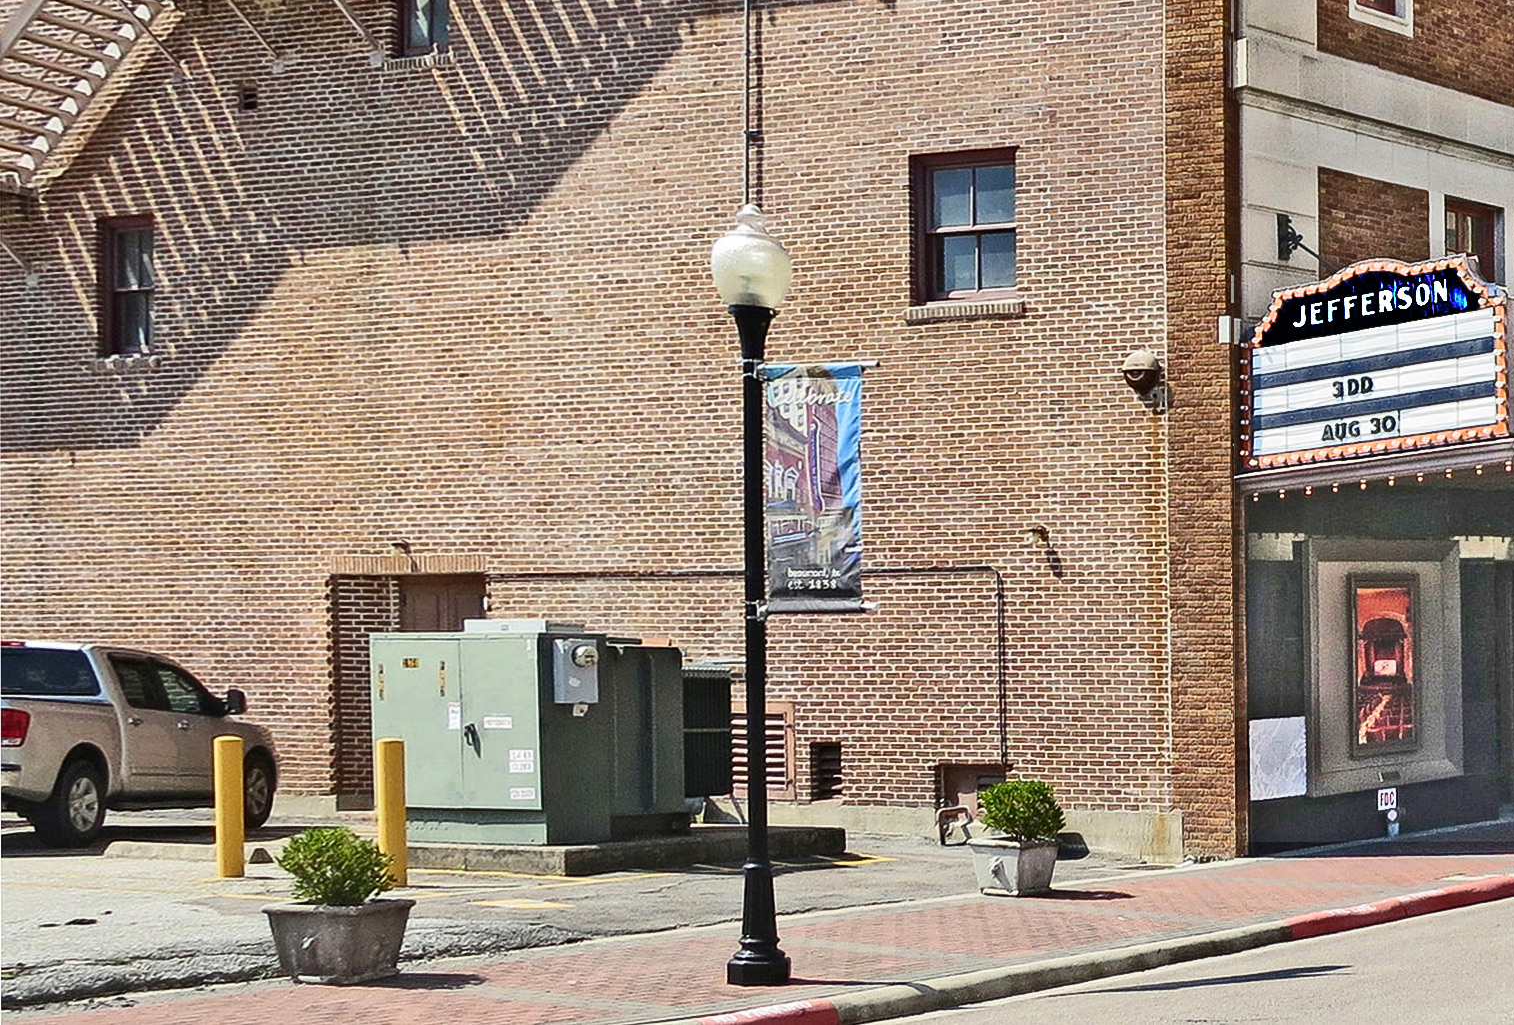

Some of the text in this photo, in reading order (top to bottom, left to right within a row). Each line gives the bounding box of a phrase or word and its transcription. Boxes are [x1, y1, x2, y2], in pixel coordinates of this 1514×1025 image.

[1293, 278, 1448, 328] JEFFERSON
[1321, 415, 1397, 442] AUG 30
[808, 579, 837, 590] 1838
[1380, 791, 1395, 807] FDC
